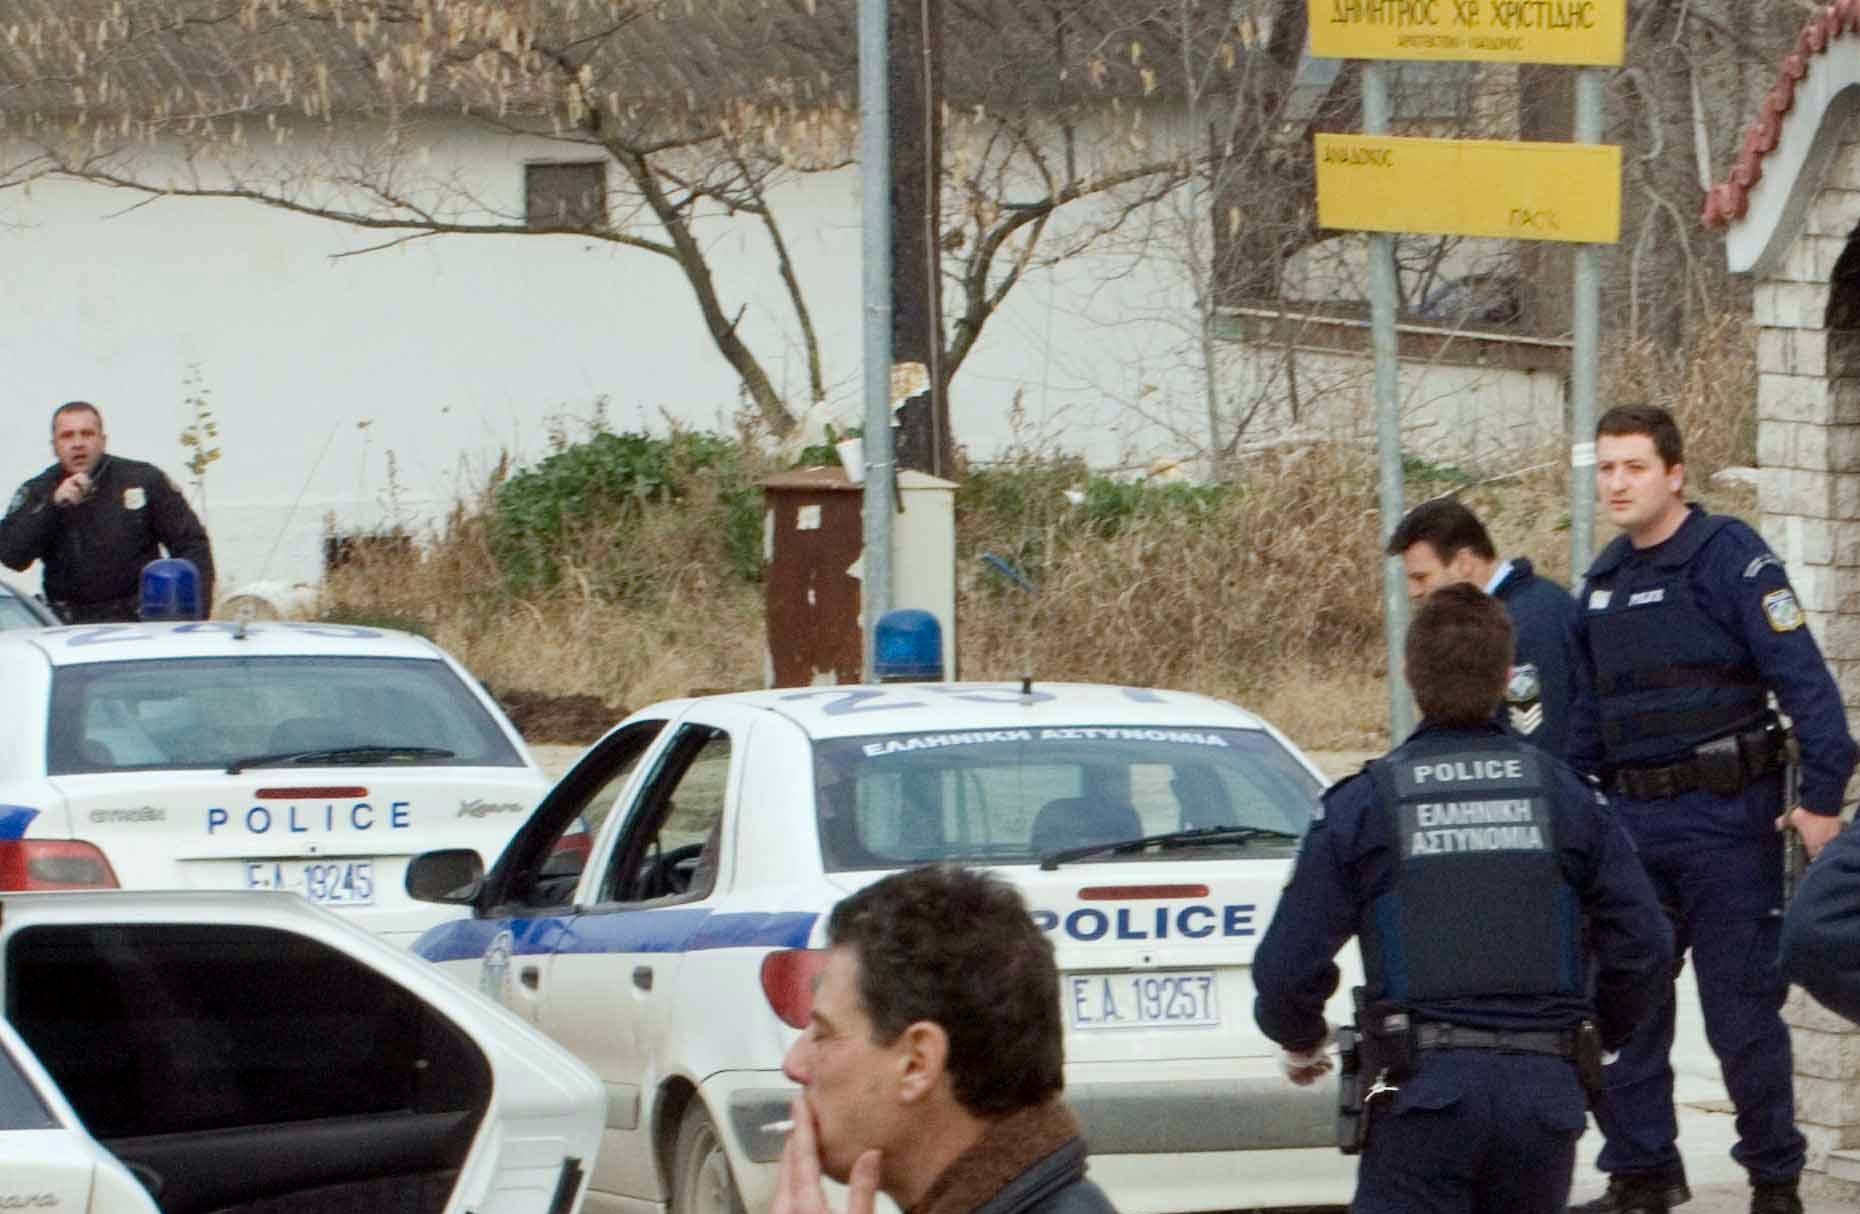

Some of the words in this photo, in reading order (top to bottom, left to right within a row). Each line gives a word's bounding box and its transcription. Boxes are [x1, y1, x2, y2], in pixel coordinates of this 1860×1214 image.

[863, 730, 1032, 757] ΕΛΛΗΝΙΚΗ
[1040, 728, 1230, 747] ΑΣΤΥΝΟΜΙΑ
[1413, 760, 1523, 784] POLICE
[207, 801, 411, 834] POLICE
[1417, 799, 1532, 827] ΕΛΛΗΝΙΚΗ
[1411, 826, 1544, 856] ΑΣΤΥΝΟΜΙΑ
[1132, 976, 1212, 1021] 19257
